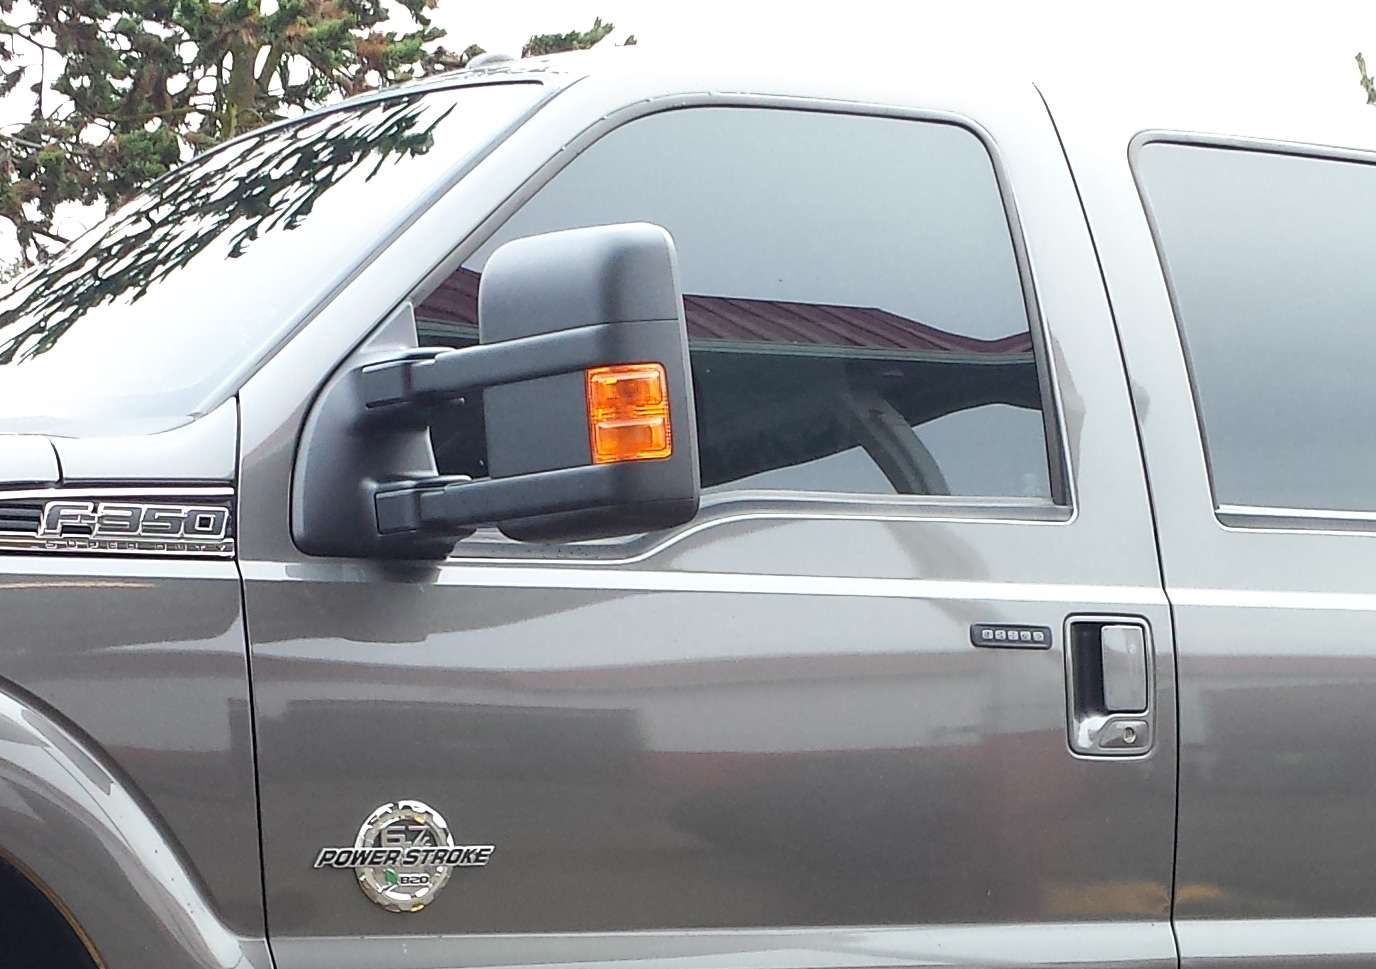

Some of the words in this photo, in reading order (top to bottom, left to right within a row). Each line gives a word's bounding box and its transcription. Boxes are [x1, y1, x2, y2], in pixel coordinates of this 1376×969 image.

[42, 500, 229, 540] F-350
[45, 540, 139, 551] SUPER
[154, 541, 227, 552] DUTY
[317, 847, 400, 867] POWER
[402, 847, 492, 866] STROKE
[399, 874, 430, 885] B20
